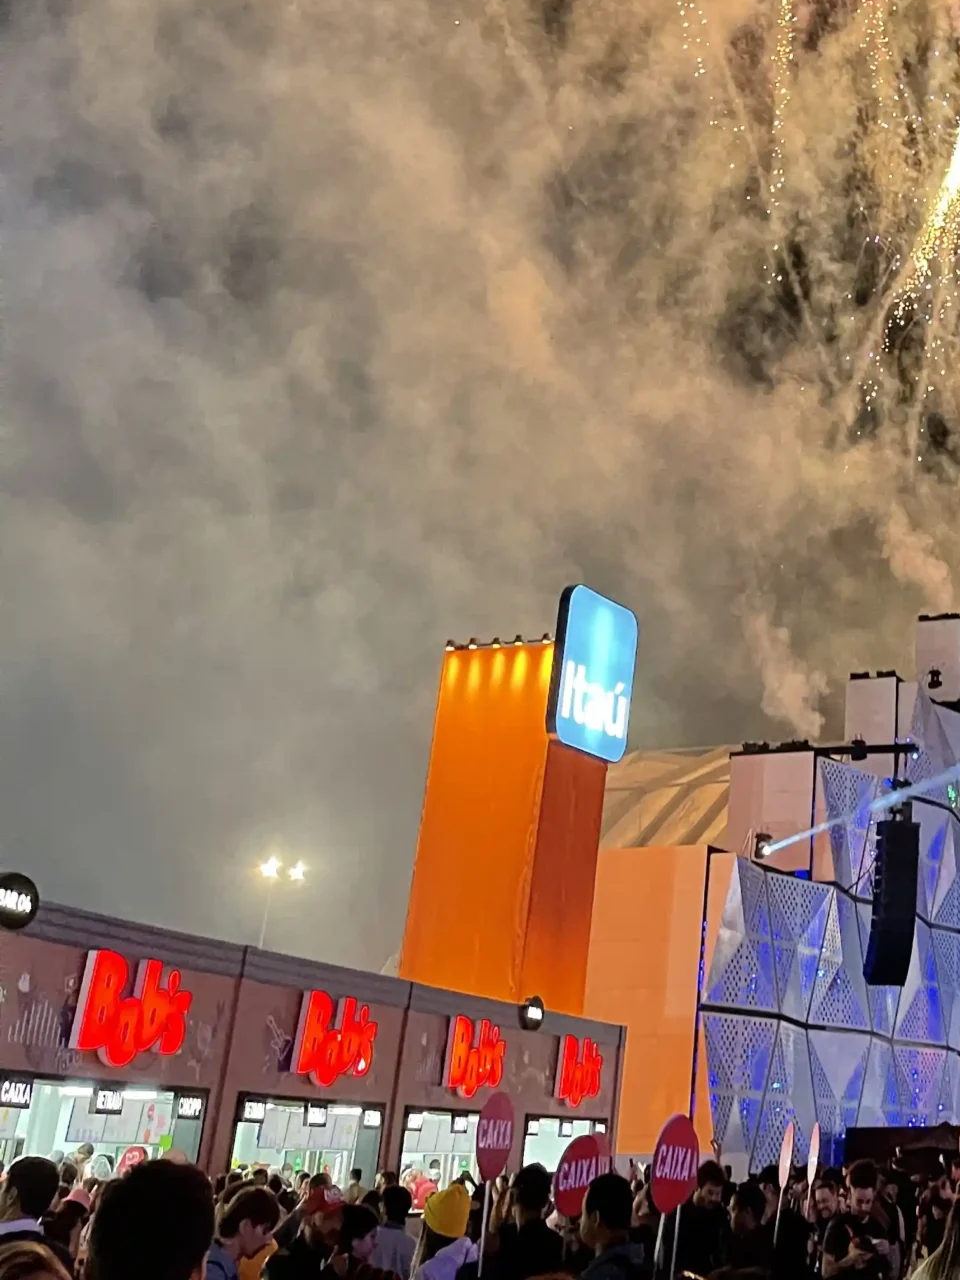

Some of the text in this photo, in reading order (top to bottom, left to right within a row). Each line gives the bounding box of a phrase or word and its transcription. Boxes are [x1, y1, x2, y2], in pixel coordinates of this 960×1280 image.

[561, 660, 628, 739] Itaú
[77, 948, 192, 1066] Bob's
[297, 990, 378, 1087] Bob's
[1, 1080, 31, 1104] CAIXA
[448, 1014, 506, 1098] Bob's
[559, 1034, 603, 1108] Bob's
[479, 1119, 512, 1150] CAIXA
[656, 1144, 692, 1181] CAIXA
[559, 1156, 597, 1191] CAIXA
